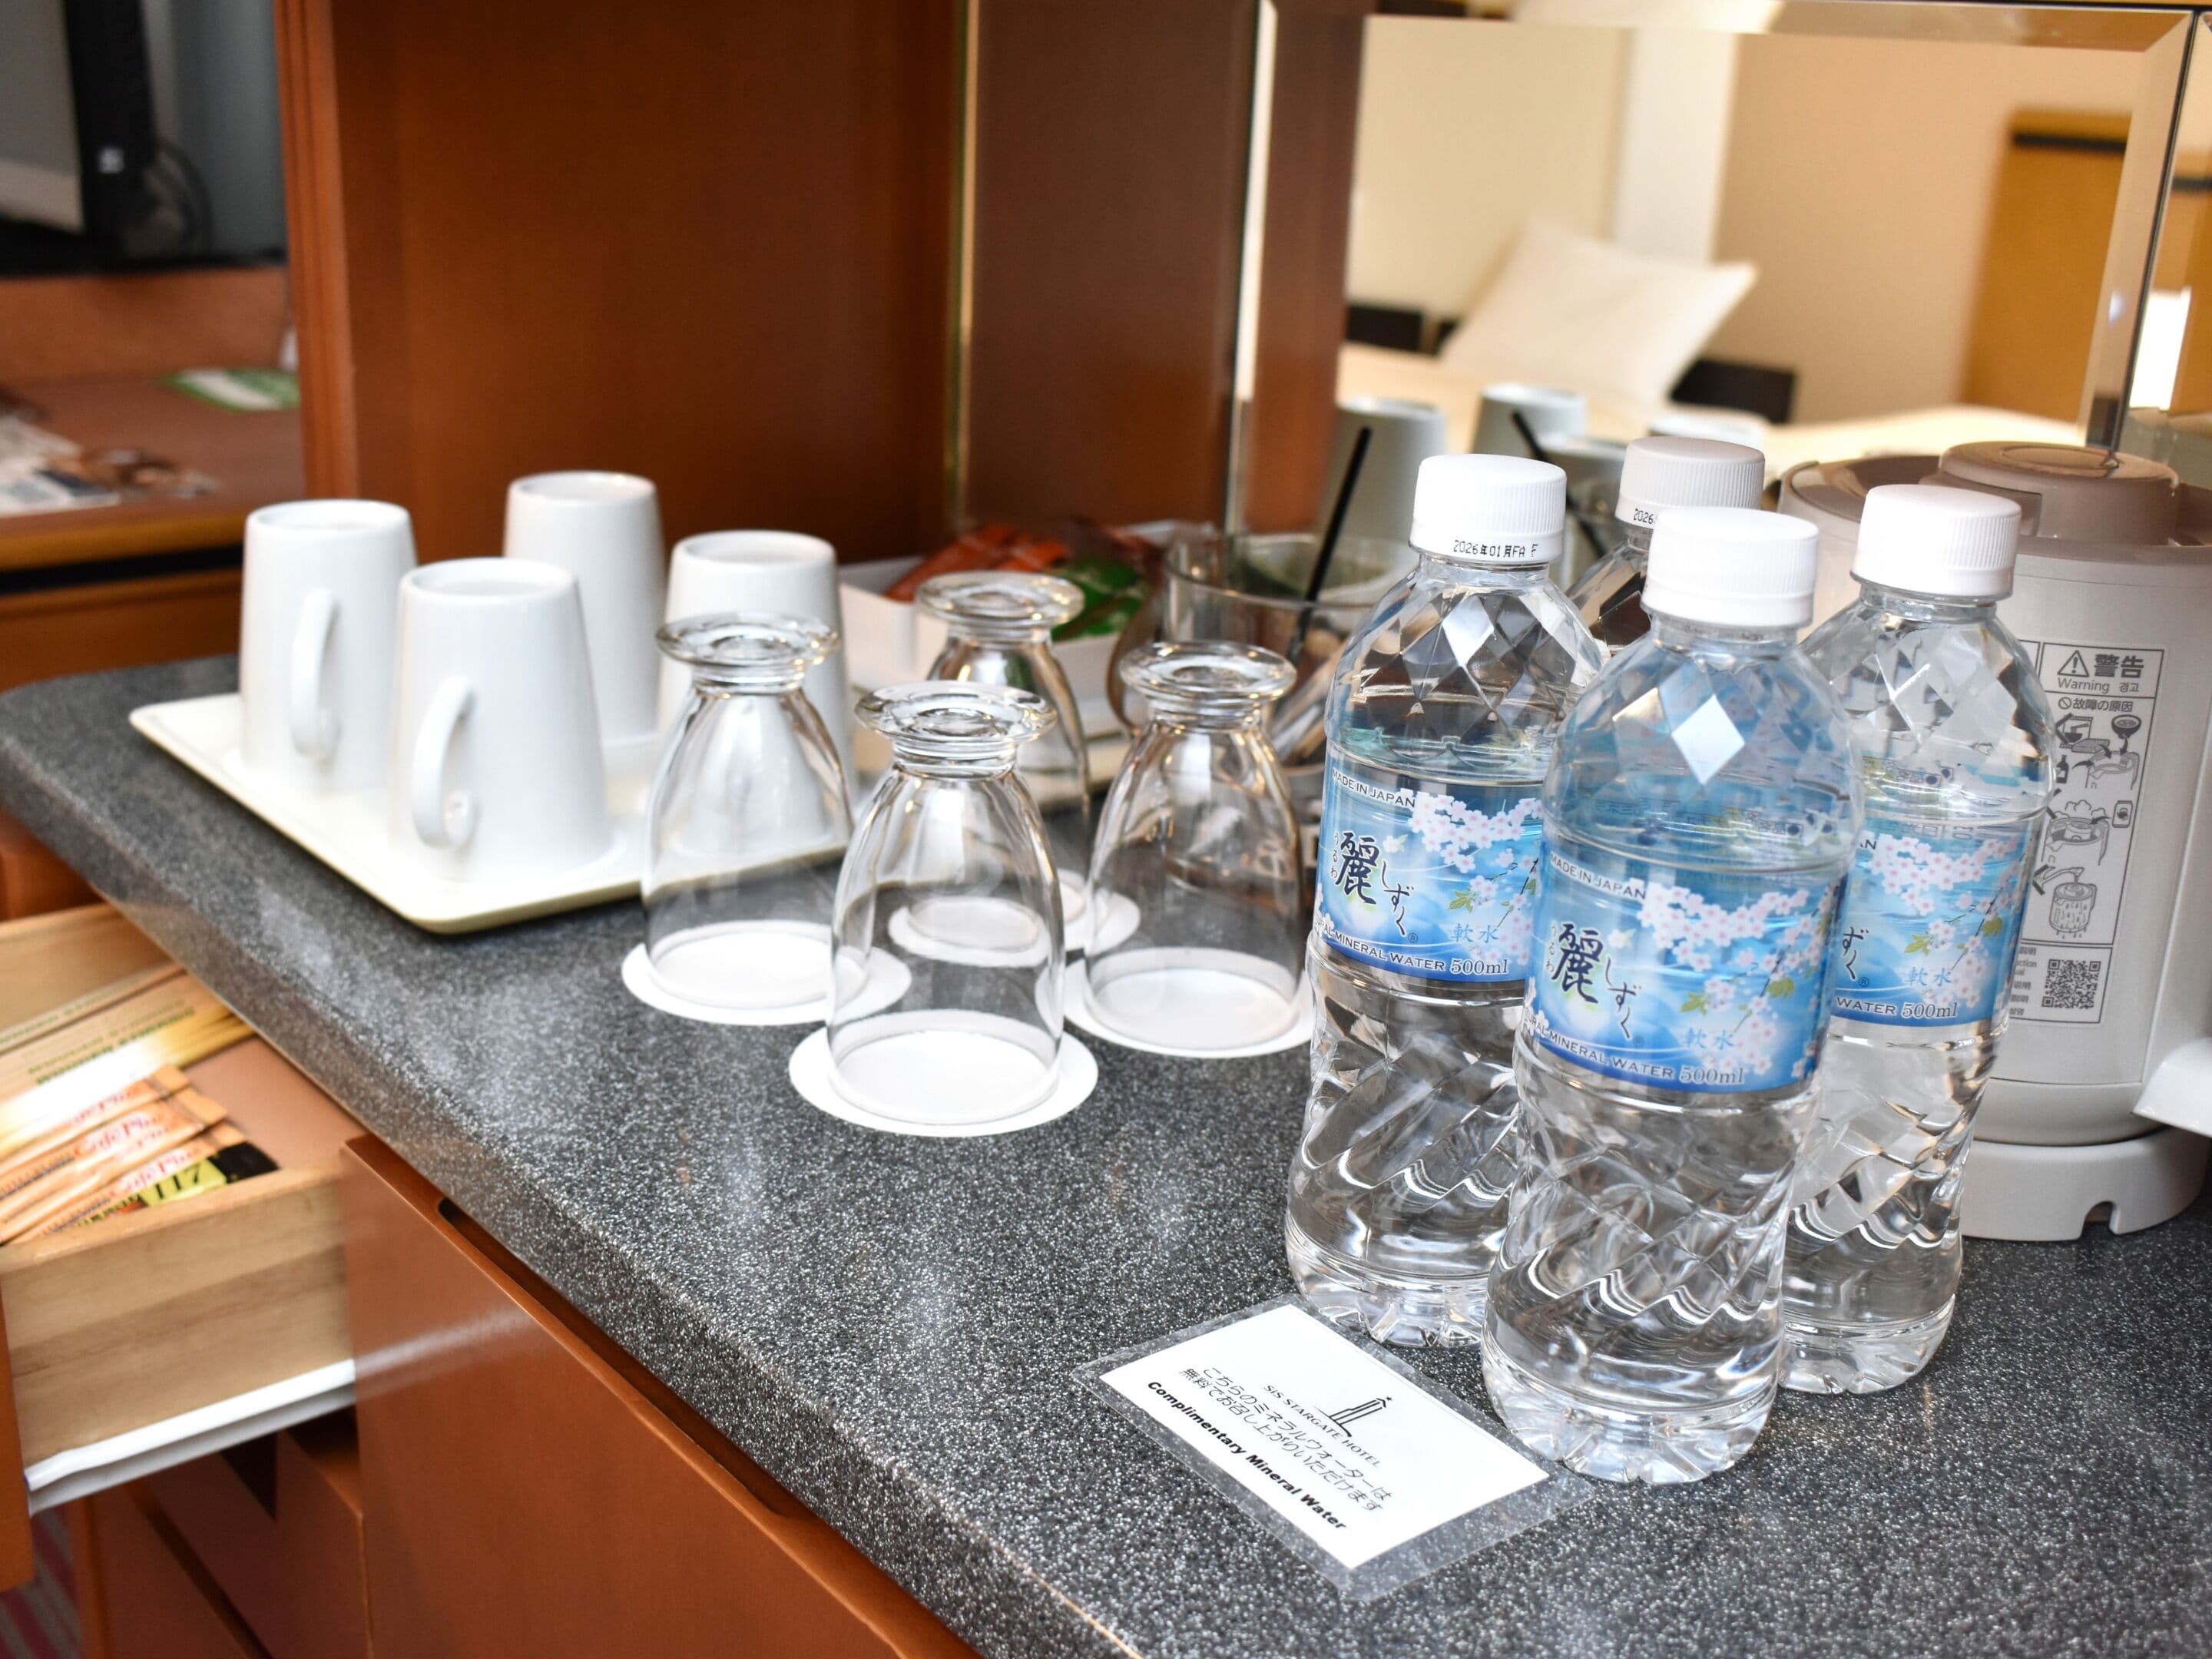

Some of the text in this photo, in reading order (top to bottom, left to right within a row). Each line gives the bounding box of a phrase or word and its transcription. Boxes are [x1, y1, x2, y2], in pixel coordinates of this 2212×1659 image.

[1633, 508, 1656, 525] 2026
[2058, 677, 2139, 694] Warning 경고
[2094, 654, 2144, 678] 警告
[2072, 697, 2134, 713] 故障の原因
[1333, 770, 1416, 808] MADE IN JAPAN
[1550, 853, 1647, 899] MADE IN JAPAN
[1335, 931, 1508, 974] MINERAL WATER 500ml
[1836, 997, 1958, 1018] WATER 500ml
[1549, 1031, 1744, 1084] MINERAL WATER 500ml
[1179, 1368, 1383, 1512] 無料でお召し上がりいただけます
[1204, 1367, 1392, 1501] こちらのミネラルウォーターは
[1283, 1399, 1343, 1440] STARGATE
[1342, 1439, 1381, 1467] HOTEL
[1147, 1381, 1347, 1529] Complimentary Mineral Water
